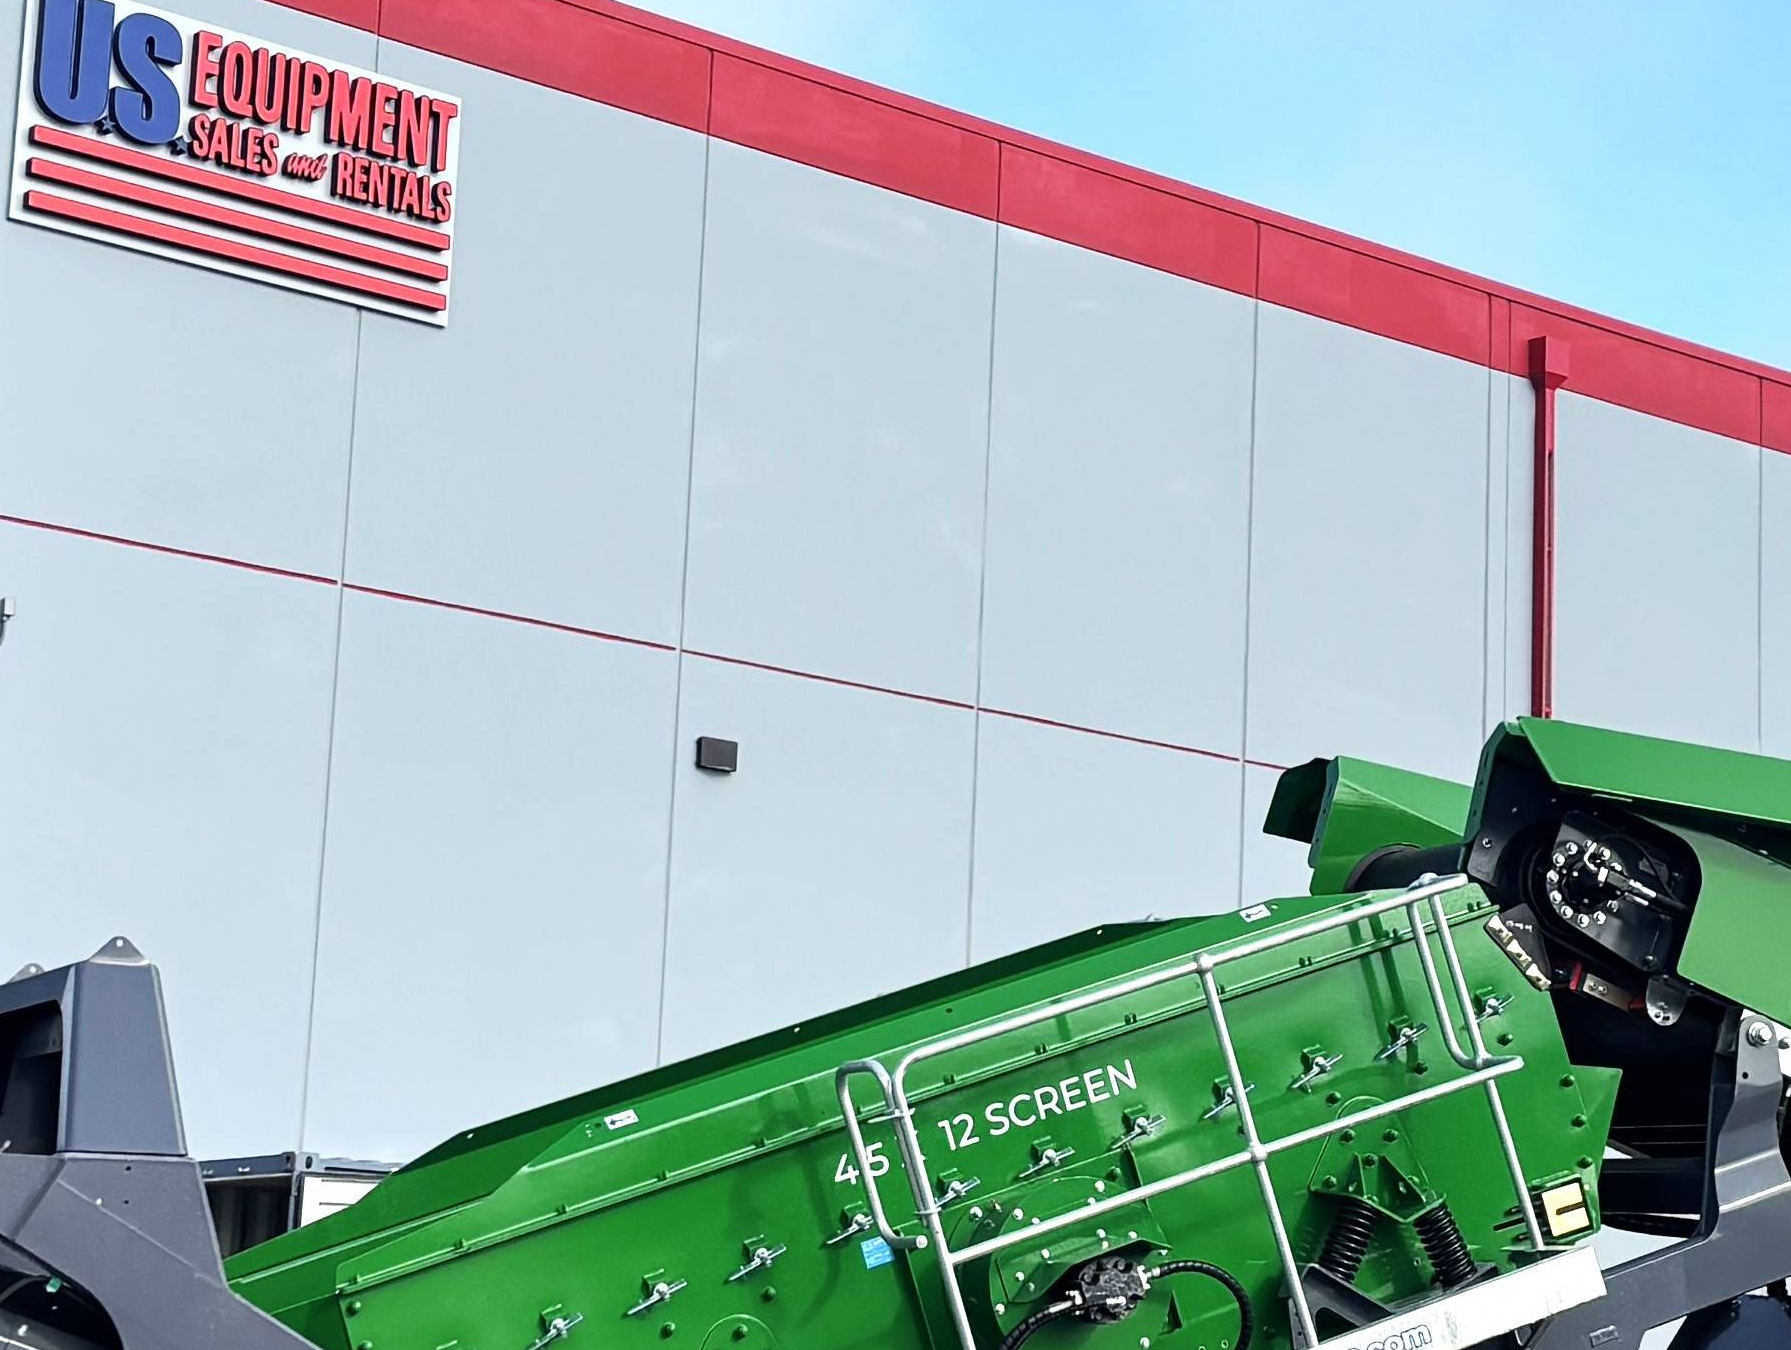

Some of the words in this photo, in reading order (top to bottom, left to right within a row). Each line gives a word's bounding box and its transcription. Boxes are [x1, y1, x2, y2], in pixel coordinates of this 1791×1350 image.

[188, 29, 458, 173] EQUIPMENT
[189, 113, 279, 176] SALES
[281, 150, 329, 184] and
[330, 151, 453, 224] RENTALS
[937, 1113, 980, 1150] 12
[985, 1058, 1137, 1136] SCREEN
